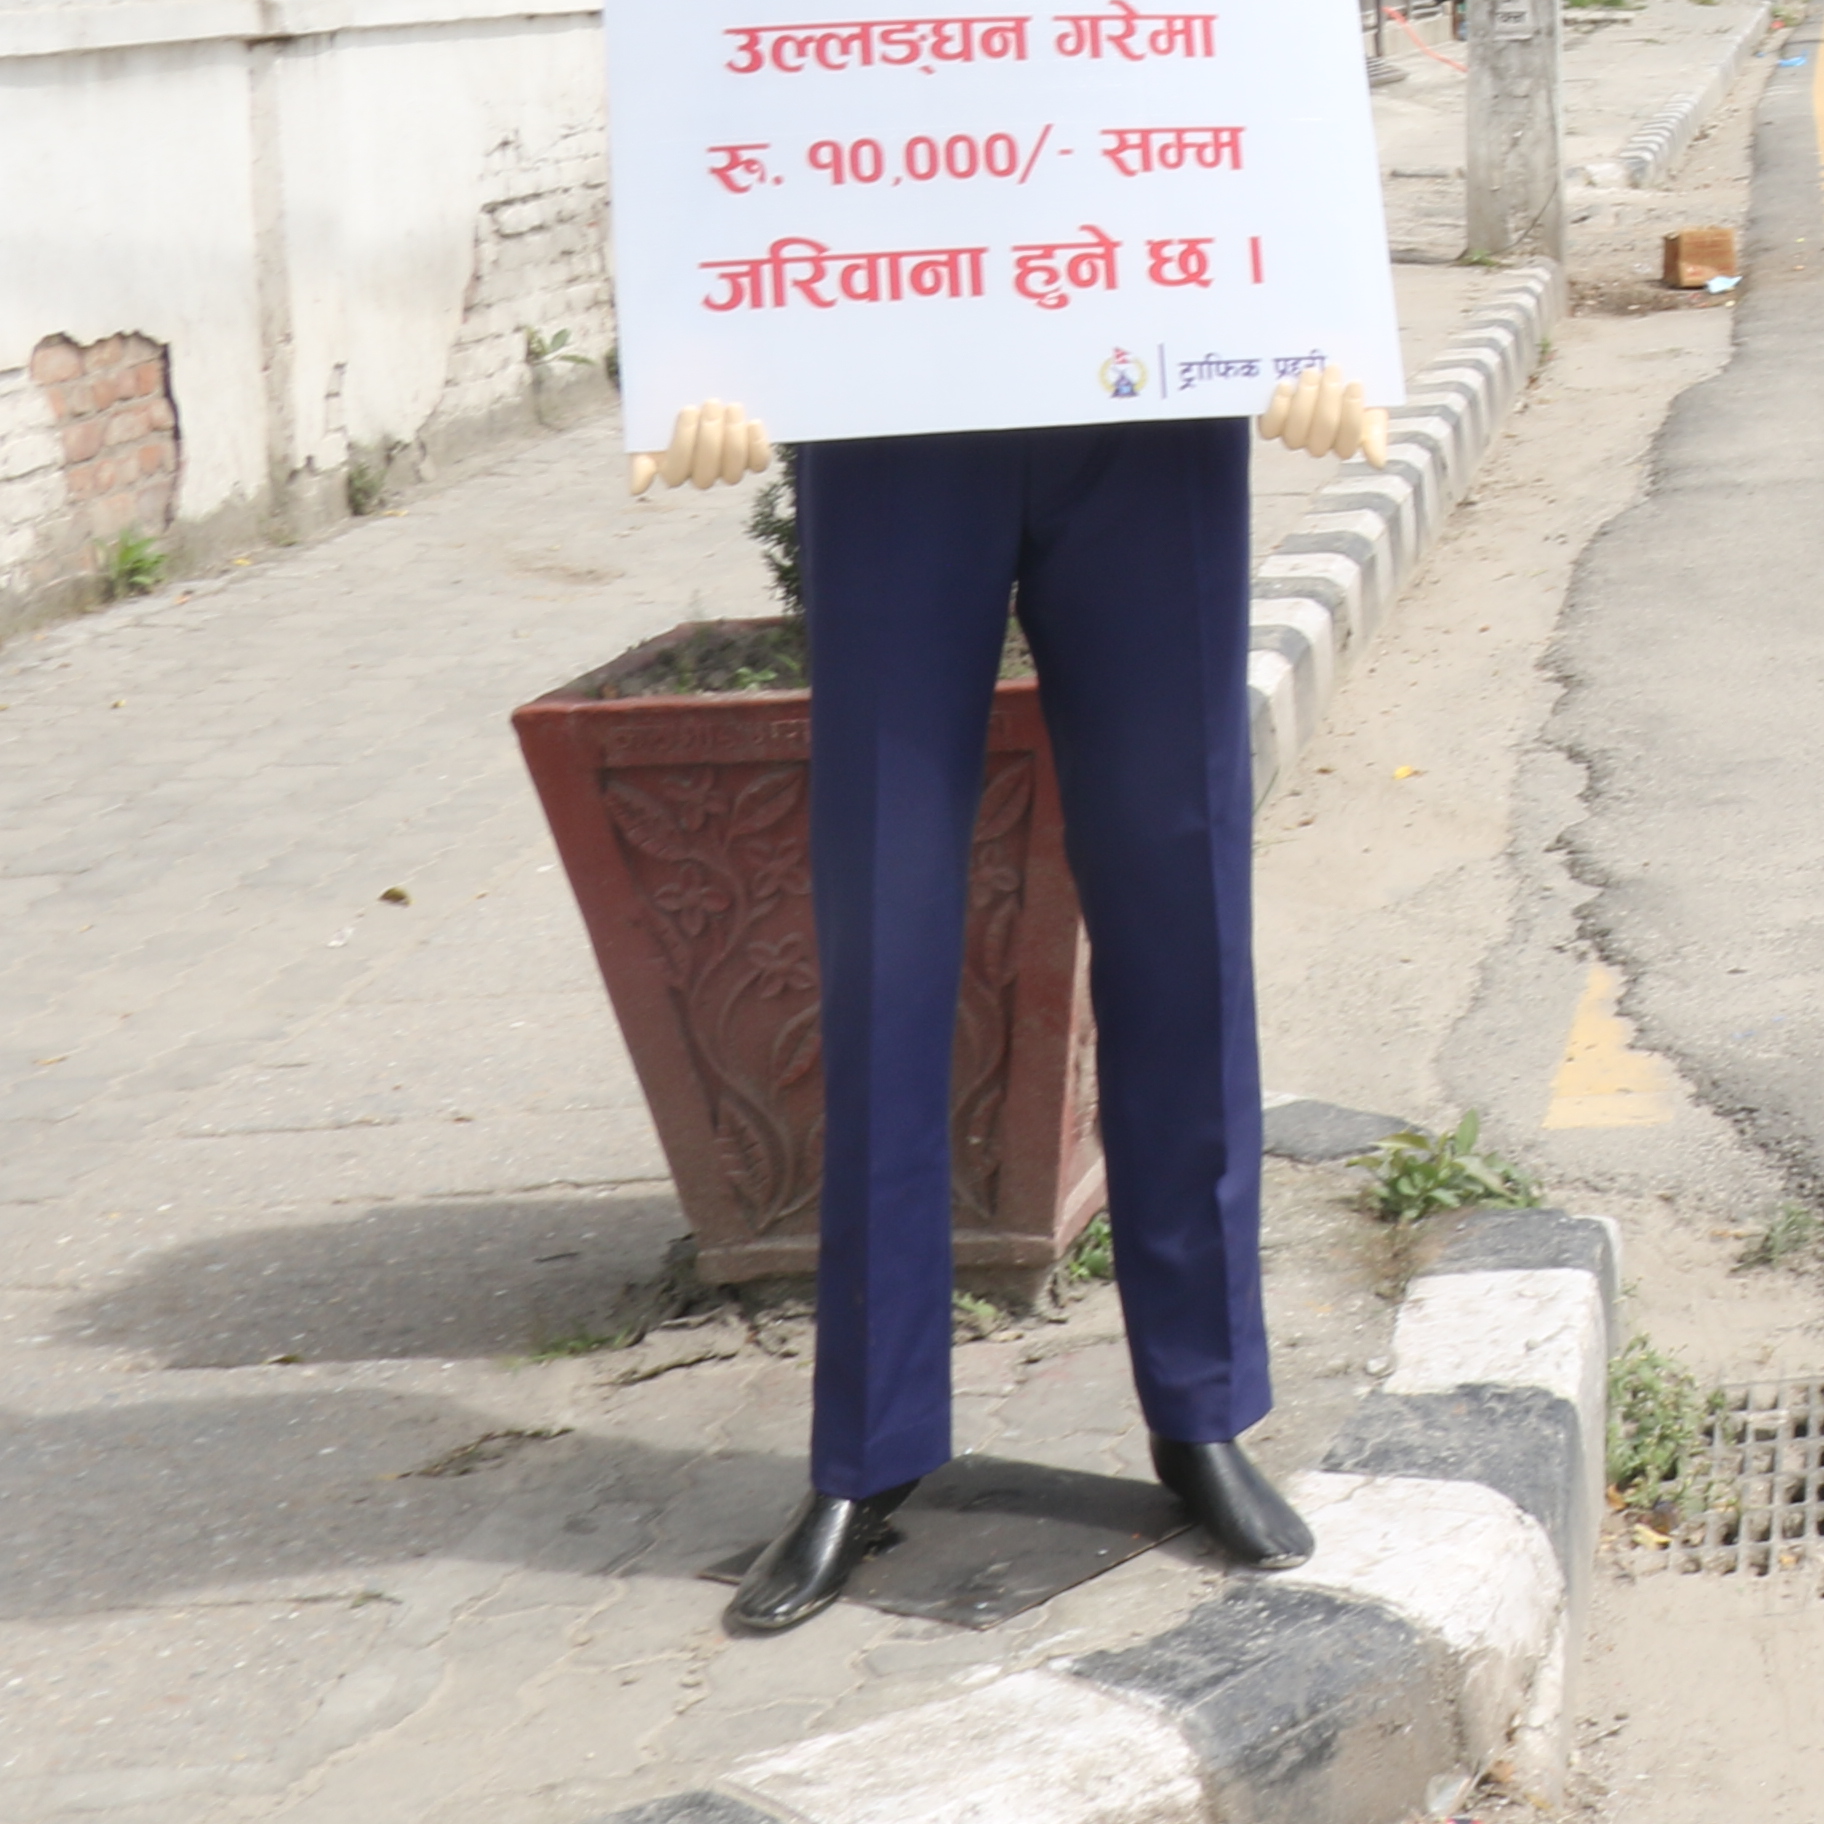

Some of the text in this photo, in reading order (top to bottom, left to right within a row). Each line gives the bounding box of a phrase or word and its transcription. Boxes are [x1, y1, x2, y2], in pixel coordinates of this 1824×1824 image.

[725, 0, 1216, 74] उल्लङ्घन गरेमा
[1102, 127, 1244, 177] सम्म
[700, 237, 988, 312] जरिवाना
[1012, 225, 1121, 310] हुने
[1180, 352, 1259, 390] ट्राफिक
